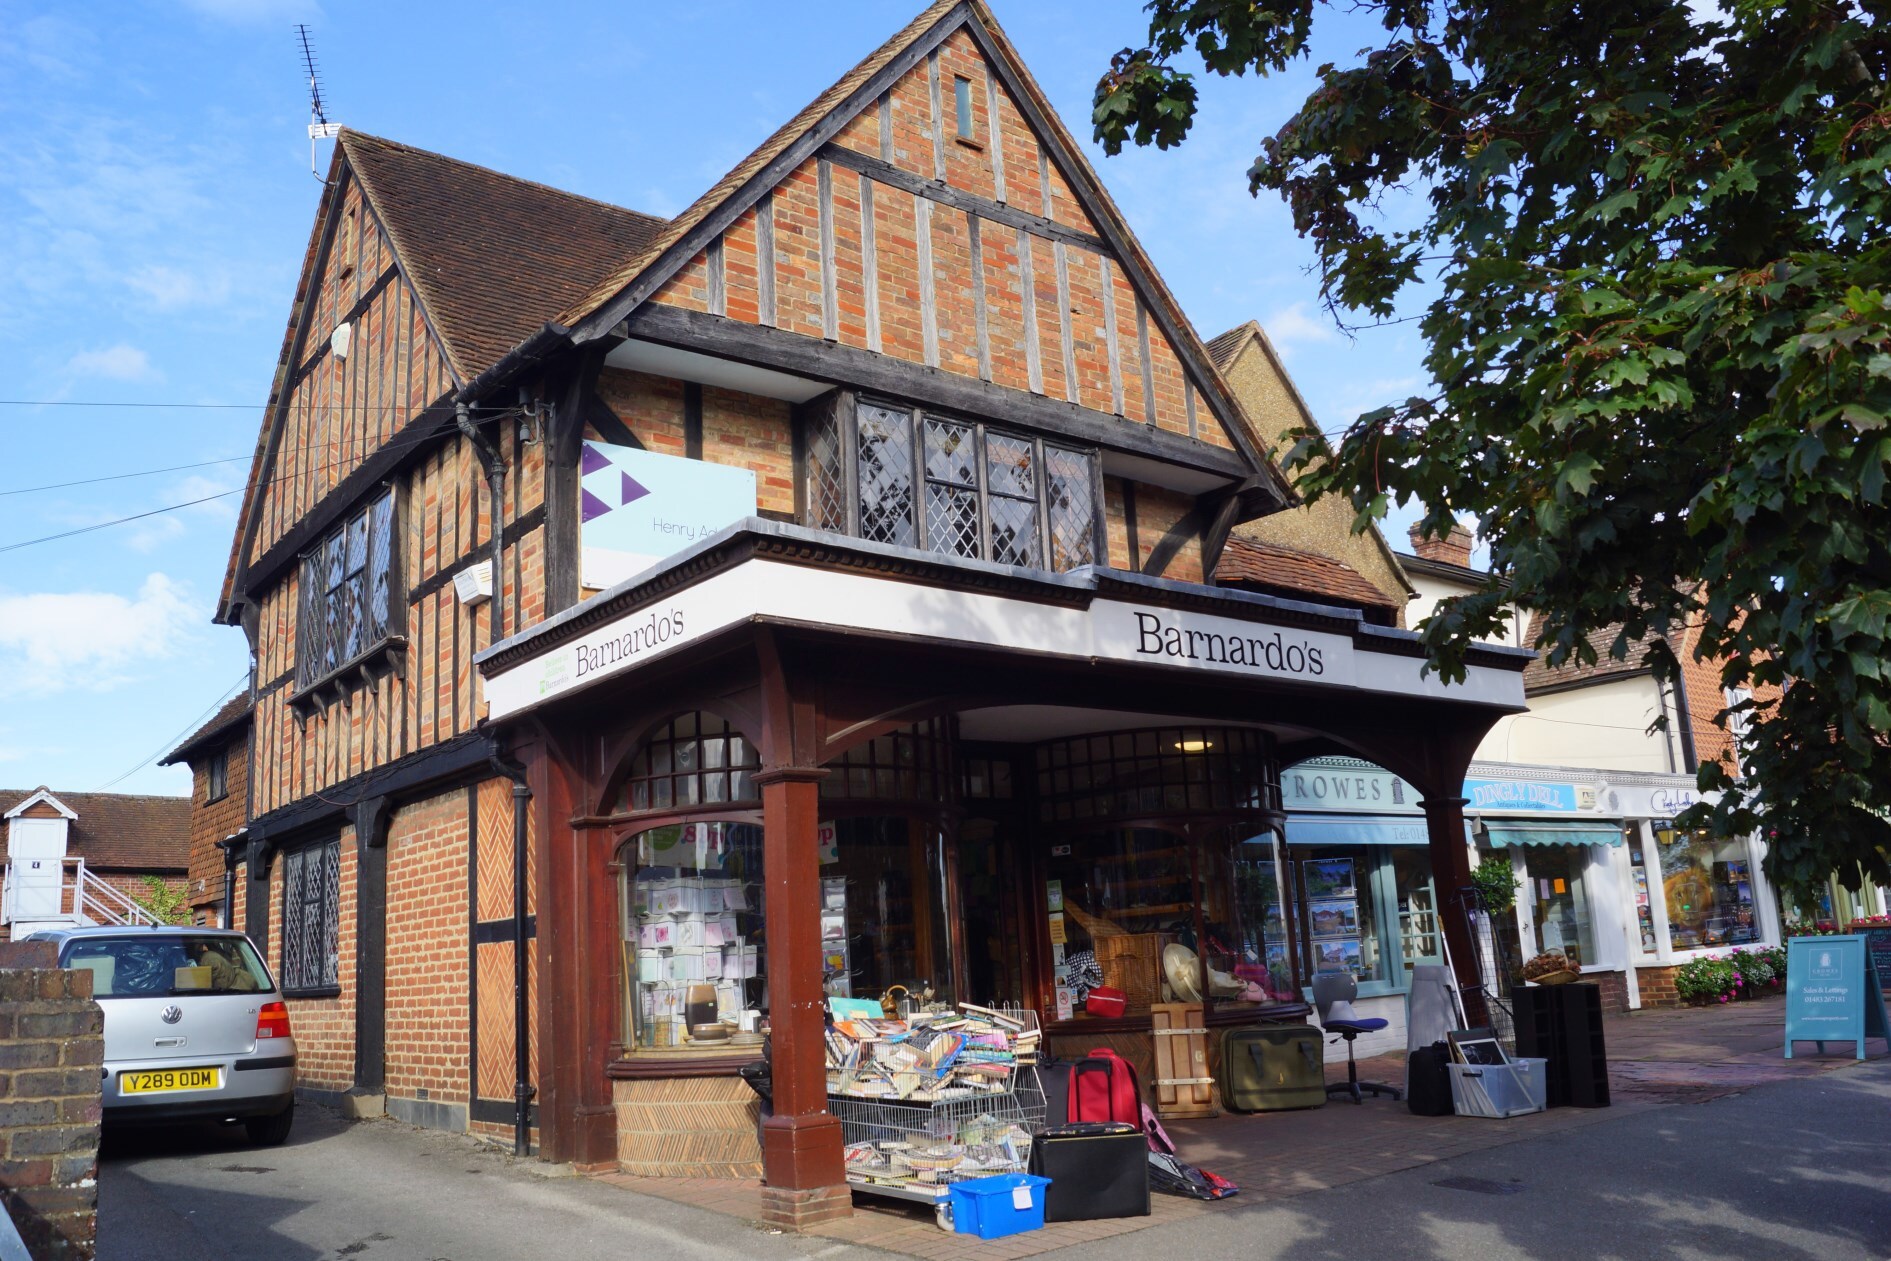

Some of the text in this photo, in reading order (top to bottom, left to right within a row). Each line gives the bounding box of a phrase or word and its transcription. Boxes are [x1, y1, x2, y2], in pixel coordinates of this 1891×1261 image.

[653, 517, 695, 541] Henry
[575, 608, 684, 678] Barnardo's
[1133, 611, 1325, 676] Barnardo's
[1472, 782, 1564, 809] DINGLY DELL
[129, 1070, 211, 1090] Y289 ODM
